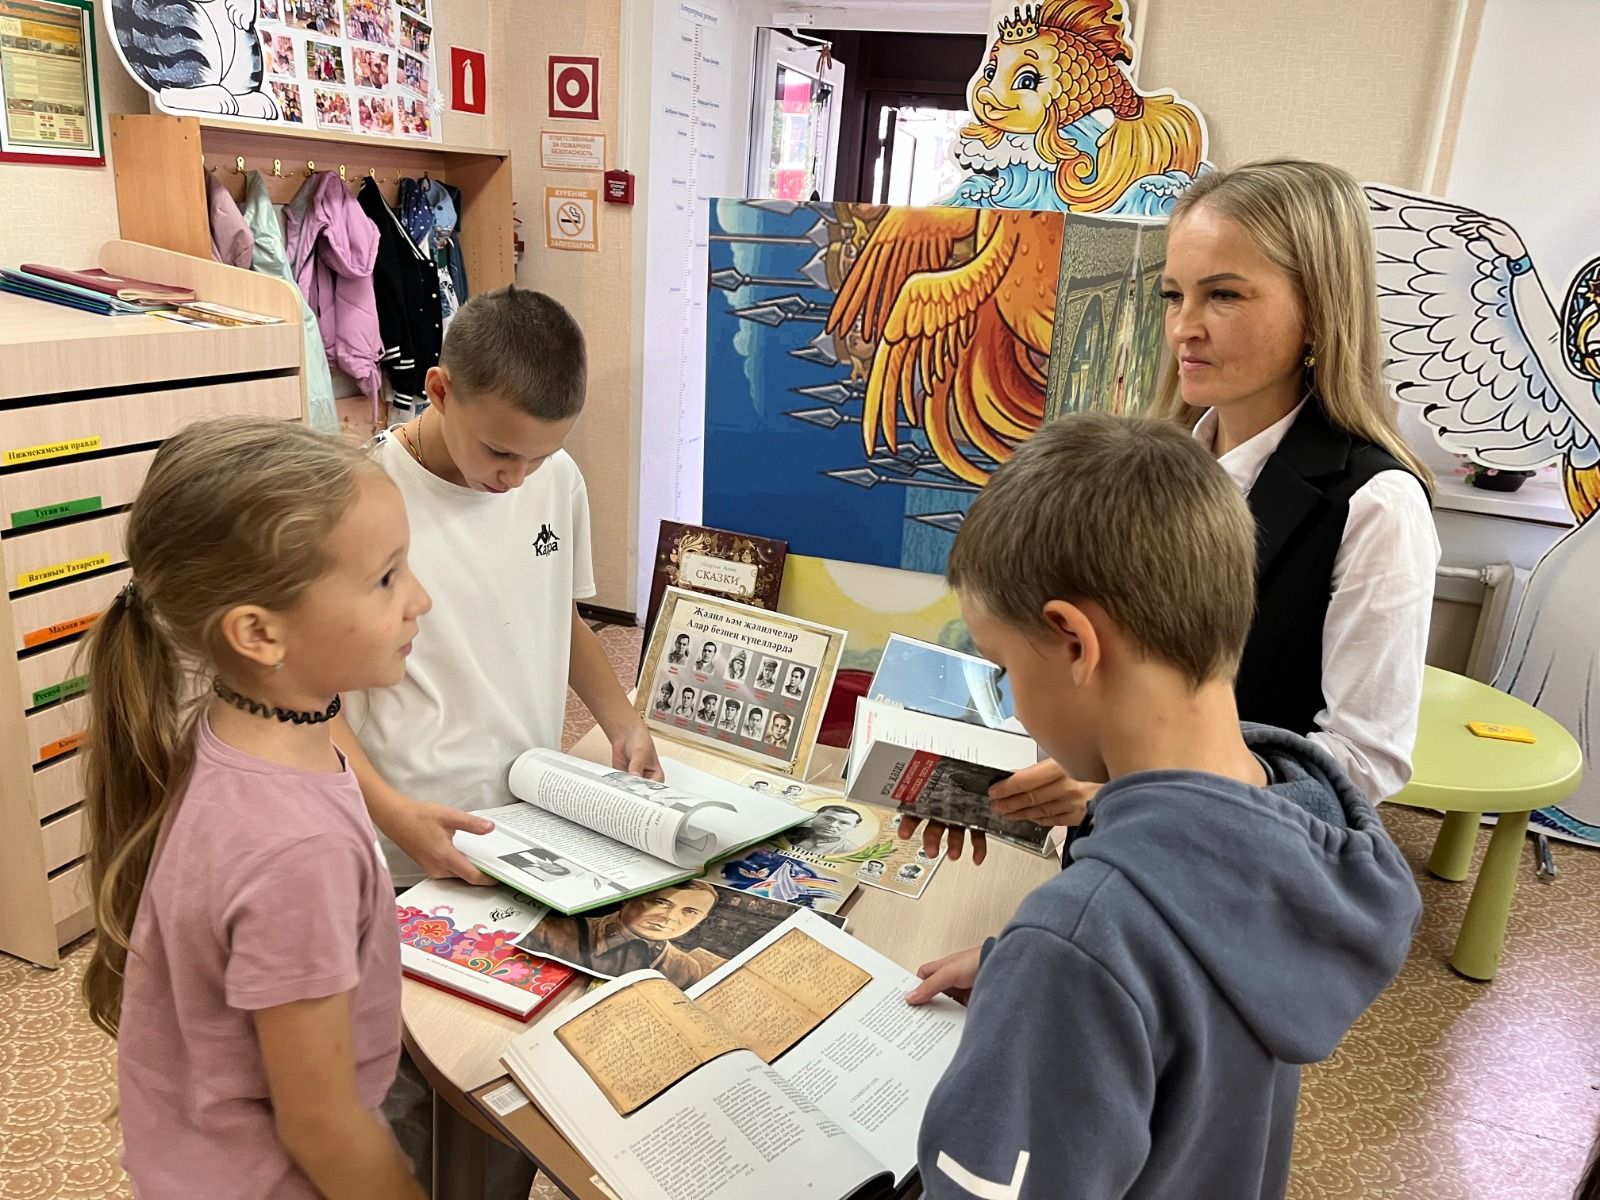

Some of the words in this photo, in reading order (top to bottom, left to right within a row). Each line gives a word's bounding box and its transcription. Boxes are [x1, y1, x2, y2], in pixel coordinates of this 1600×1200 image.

[560, 142, 592, 150] ПОЖАРНУЮ
[551, 148, 593, 157] БЕЗОПАСНОСТЬ
[554, 190, 588, 198] КУРЕНИЕ
[550, 239, 594, 249] ЗАПРЕЩЕНО
[8, 443, 69, 460] Нижнекамская
[71, 438, 98, 450] правда
[34, 507, 55, 519] Туган
[28, 568, 65, 583] Ватаным
[66, 557, 105, 573] Татарстан
[695, 569, 741, 586] СКАЗКИ
[687, 618, 710, 633] Алар
